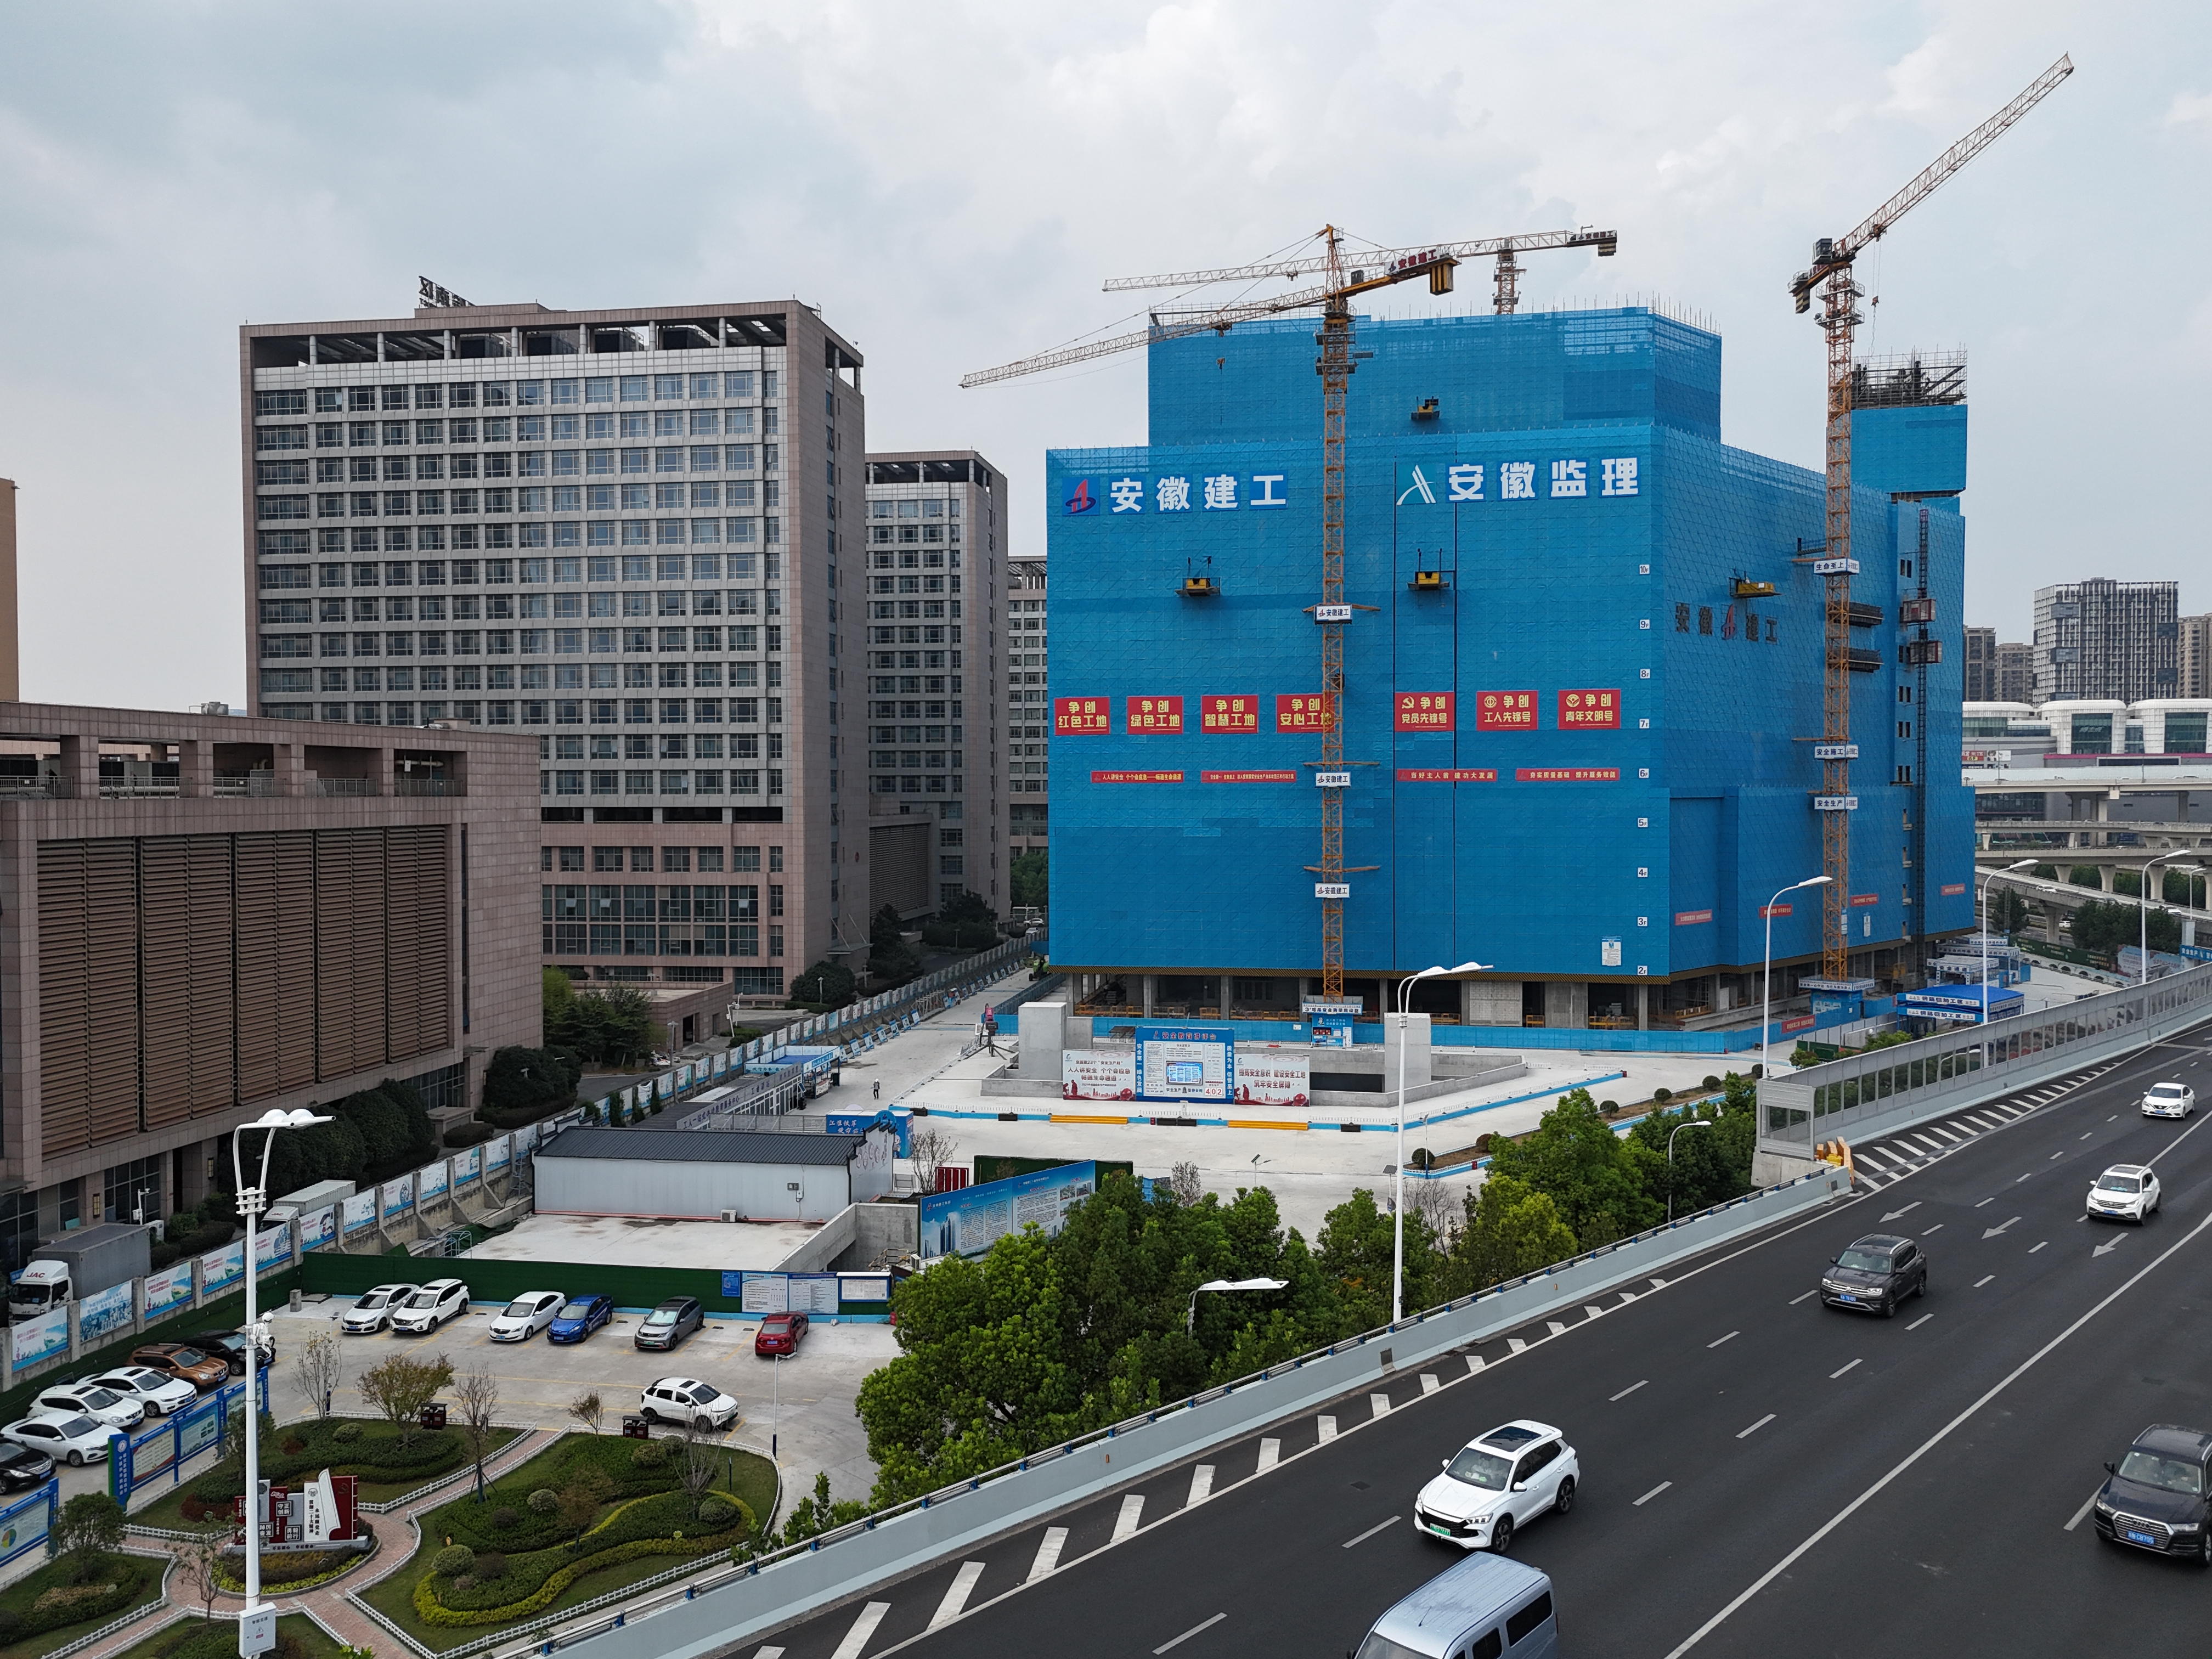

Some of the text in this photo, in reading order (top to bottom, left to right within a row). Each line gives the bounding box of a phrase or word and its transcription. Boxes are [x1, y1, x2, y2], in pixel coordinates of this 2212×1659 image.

[1448, 457, 1638, 501] 安徽监理
[1110, 474, 1286, 512] 安徽建工
[1816, 562, 1844, 571] 生命至上
[1141, 700, 1169, 713] 争创
[1216, 699, 1244, 712] 争创
[1291, 698, 1320, 711] 争创
[1420, 696, 1446, 709] 争创
[1503, 695, 1529, 708] 争创
[1585, 693, 1611, 707] 争创
[1068, 701, 1096, 714] 争创
[1058, 715, 1107, 728] 红色工地
[1131, 714, 1180, 727] 绿色工地
[1205, 713, 1255, 726] 智慧工地
[1402, 713, 1447, 724] 党员先锋号
[1484, 711, 1531, 723] 工人先锋号
[1566, 710, 1613, 721] 青年文明号
